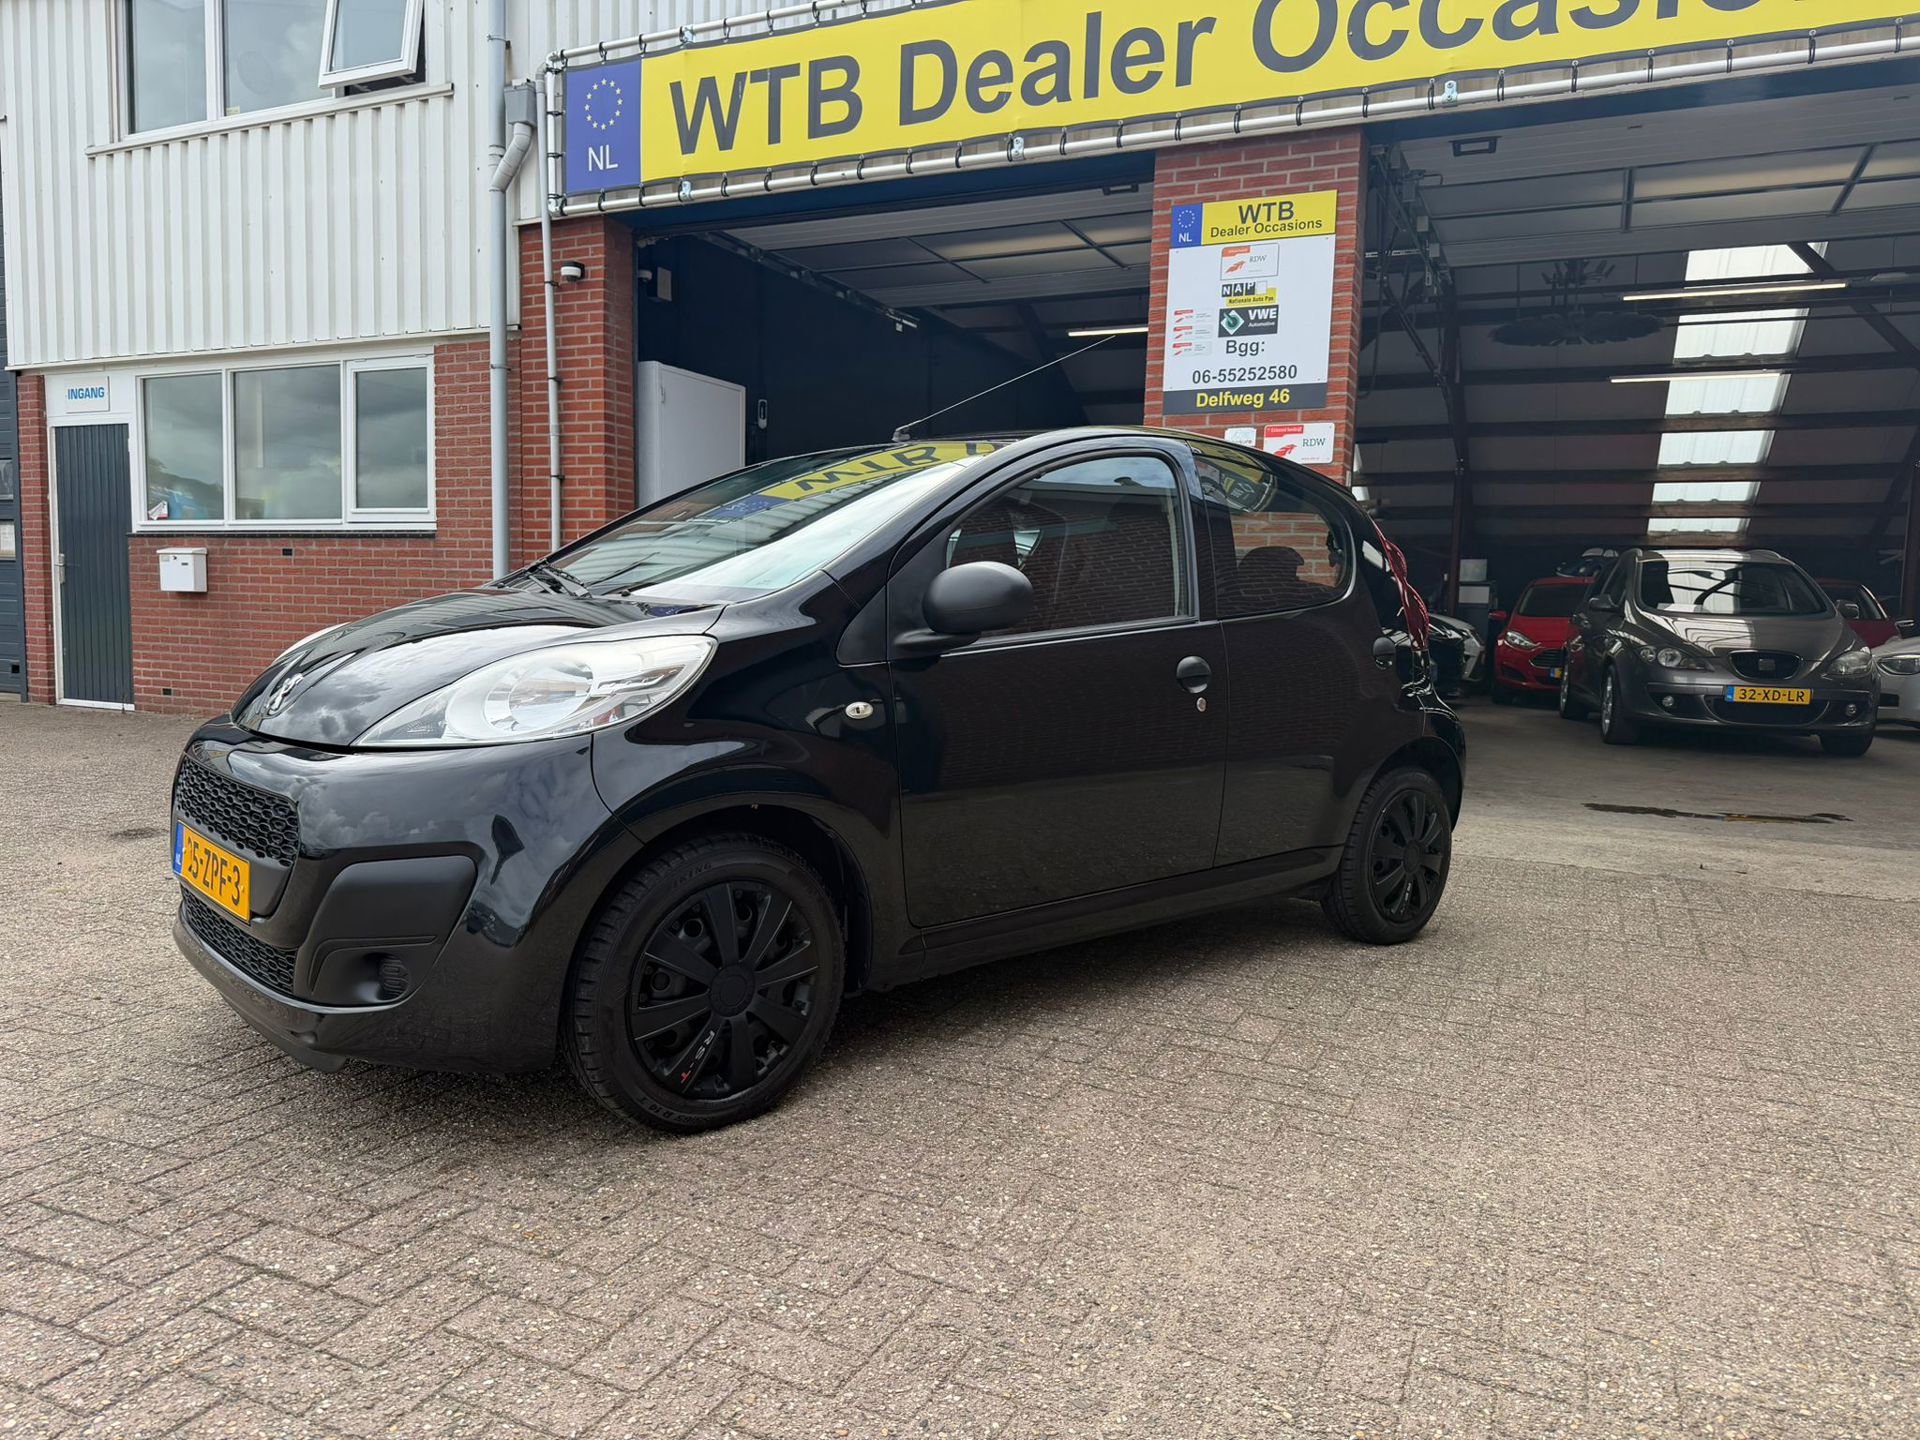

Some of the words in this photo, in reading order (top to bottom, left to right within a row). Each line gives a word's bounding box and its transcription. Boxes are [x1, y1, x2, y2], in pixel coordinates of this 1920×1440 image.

[669, 54, 863, 155] WTB
[900, 10, 1217, 127] Dealer
[1252, 0, 1763, 73] Occa
[588, 144, 618, 171] NL
[1238, 201, 1294, 224] WTB
[1211, 226, 1250, 238] Dealer
[1254, 219, 1323, 234] Occasions
[1178, 233, 1192, 243] NL
[1222, 283, 1255, 296] NAP
[1248, 308, 1277, 320] VWE
[1226, 340, 1265, 357] Bgg:
[1192, 365, 1298, 384] 06-55252580
[68, 387, 105, 400] INGANG
[1196, 391, 1264, 409] Delfweg
[1269, 388, 1290, 404] 46
[1302, 438, 1326, 447] RDW
[1738, 688, 1805, 702] 32-XD-LR
